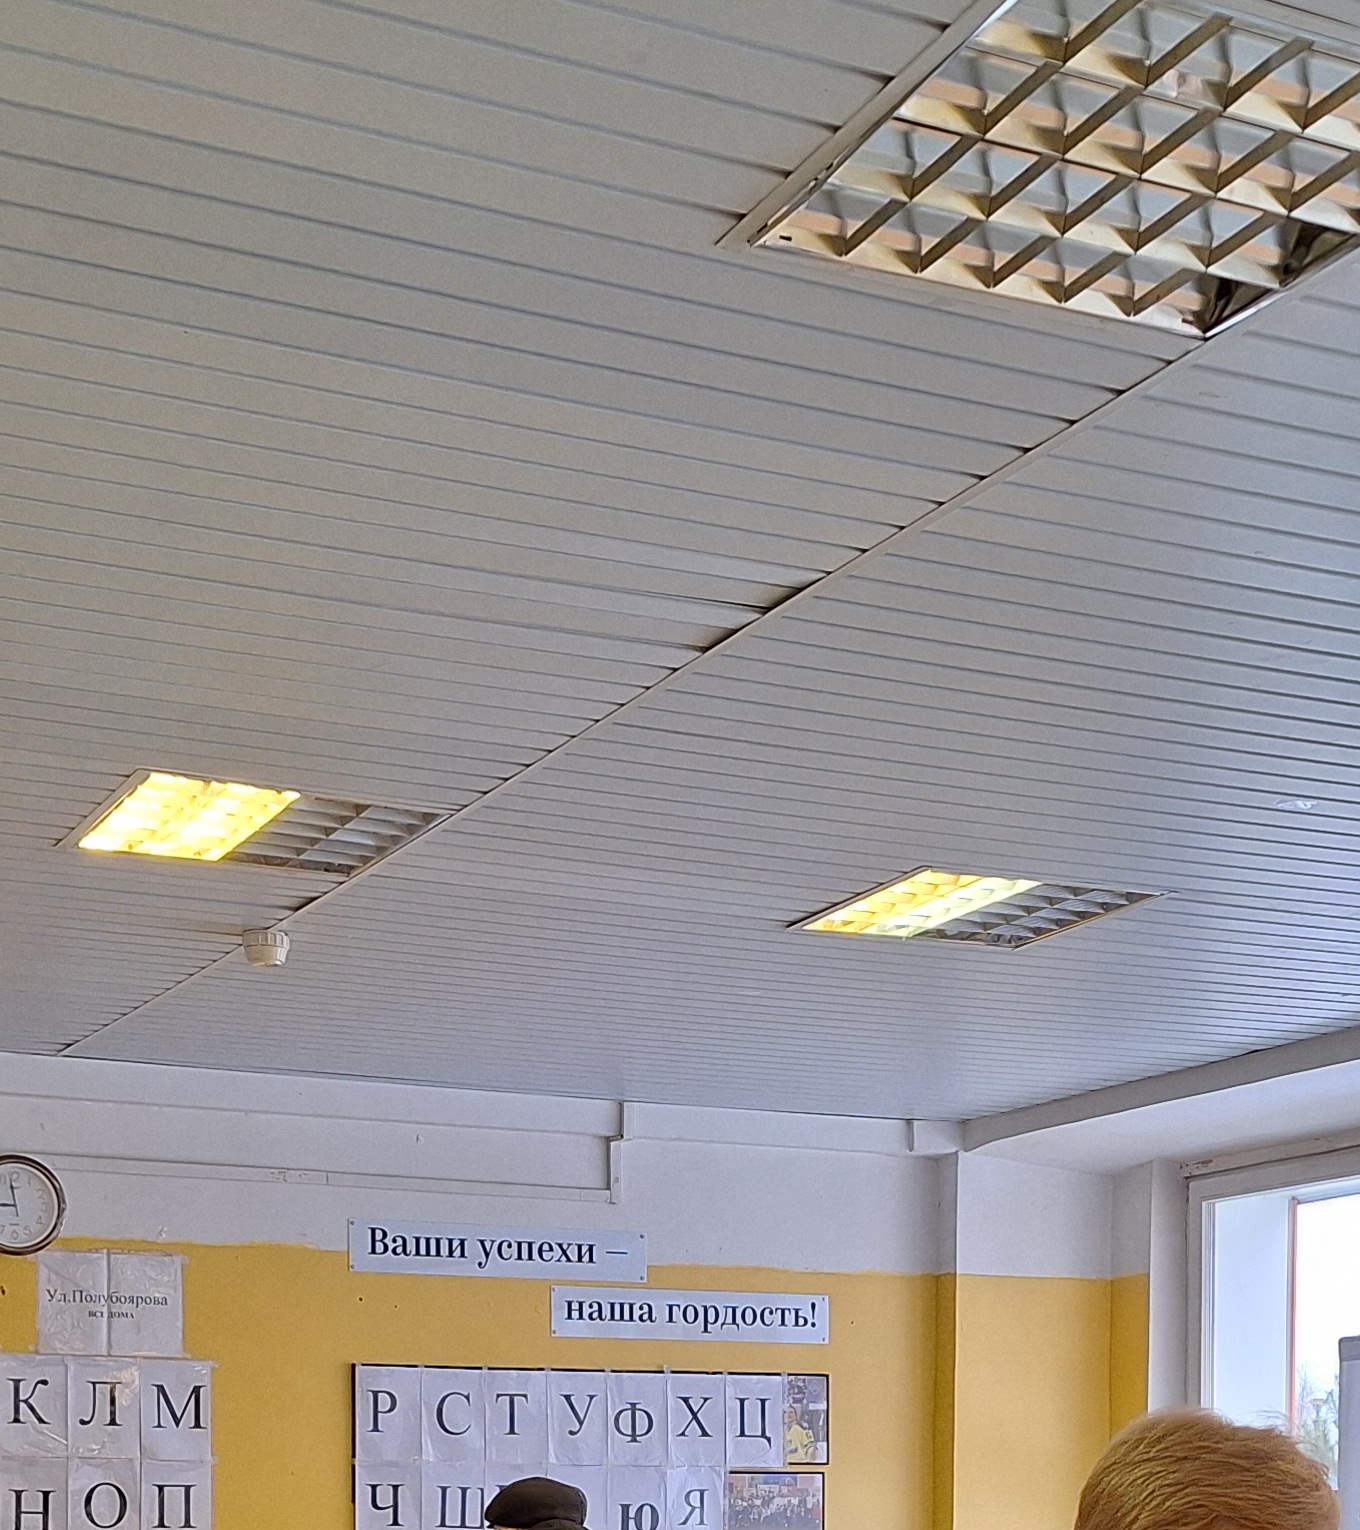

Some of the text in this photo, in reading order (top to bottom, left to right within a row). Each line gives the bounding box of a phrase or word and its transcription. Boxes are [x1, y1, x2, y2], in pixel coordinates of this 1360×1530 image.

[367, 1226, 468, 1260] Ваши
[477, 1235, 597, 1269] успехи
[46, 1288, 168, 1309] Ул.Полубоярова
[564, 1298, 818, 1334] наша гордость!
[6, 1378, 207, 1430] К Л М
[366, 1389, 772, 1449] Р С Т У Ф Х Ц
[83, 1482, 128, 1529] О
[151, 1484, 197, 1529] П
[365, 1483, 405, 1528] Ч
[434, 1486, 485, 1530] Ш
[677, 1488, 710, 1527] Я
